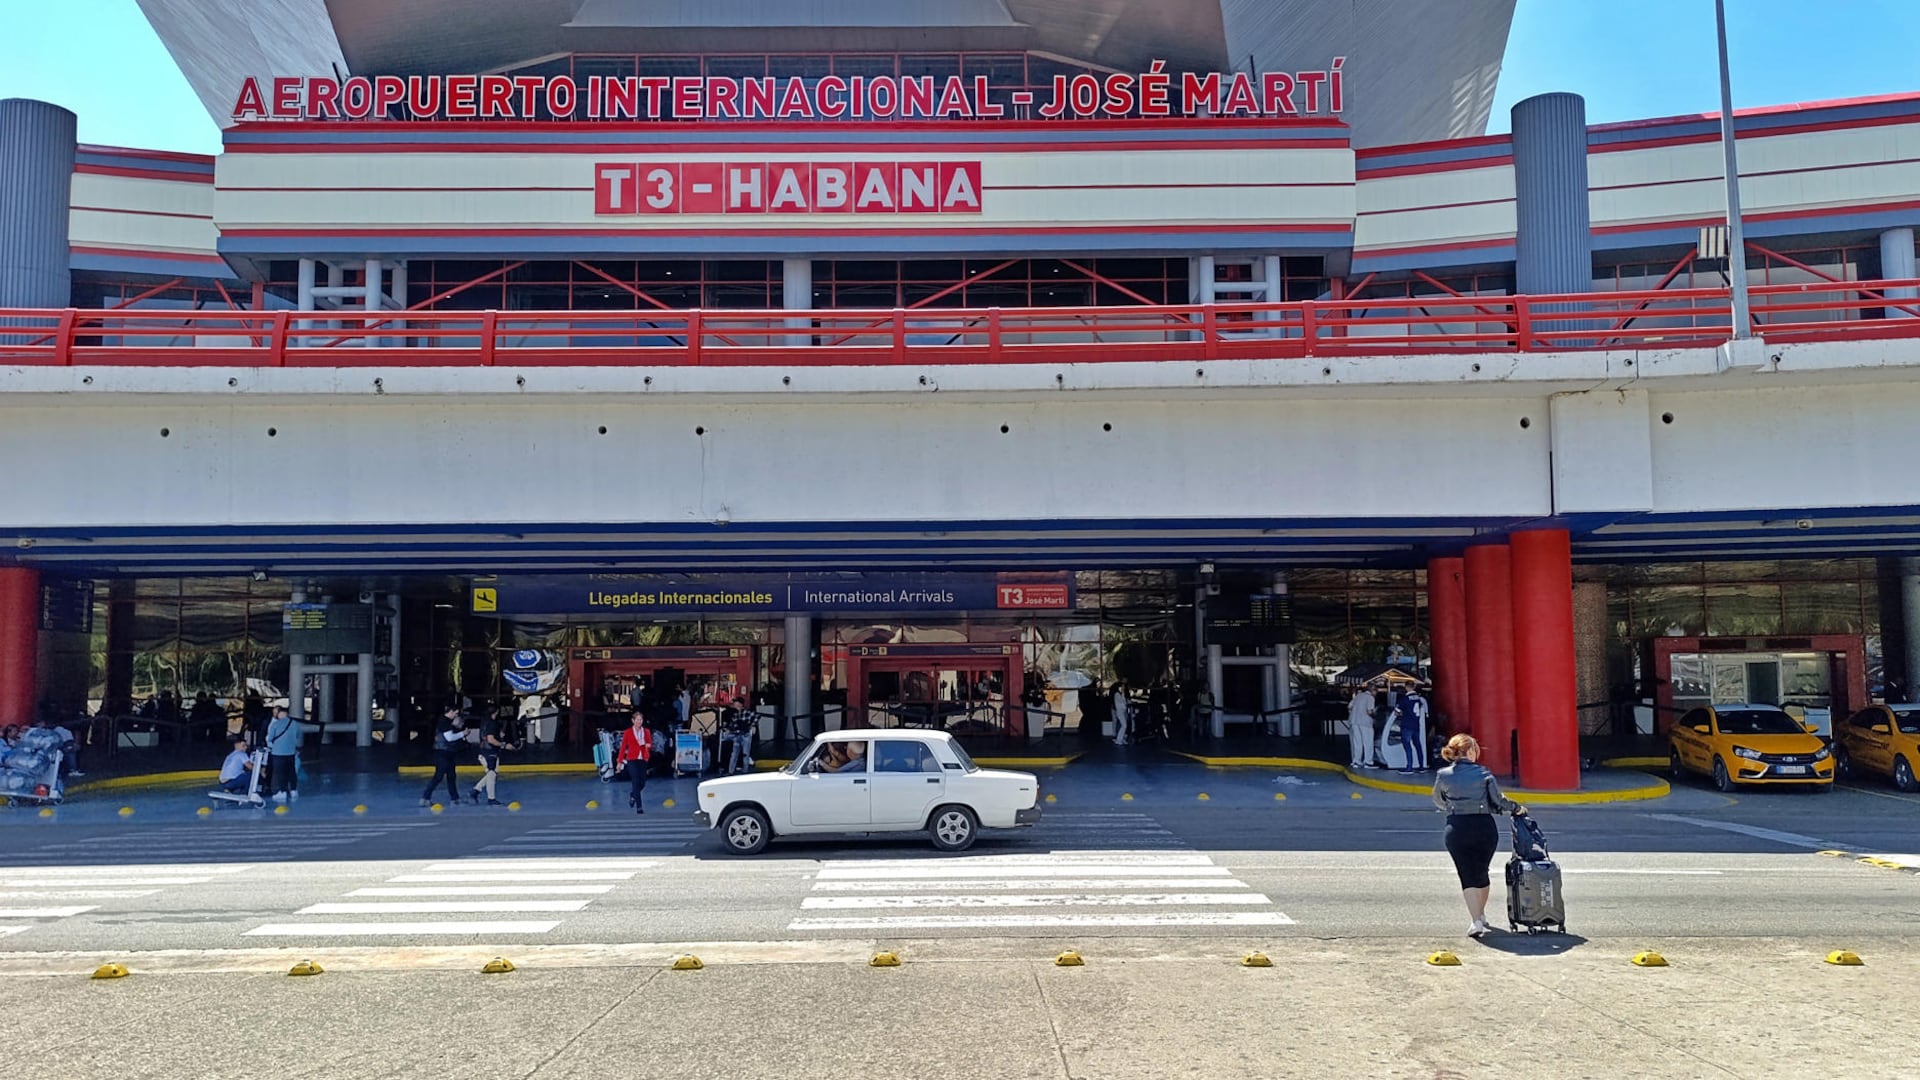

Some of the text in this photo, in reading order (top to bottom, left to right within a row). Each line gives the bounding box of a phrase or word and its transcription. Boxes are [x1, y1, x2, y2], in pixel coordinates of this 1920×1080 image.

[232, 75, 576, 118] AEROPUERTO
[587, 75, 1004, 118] INTERNACIONAL
[1038, 59, 1170, 117] JOSÉ
[1181, 56, 1348, 115] MARTÍ
[588, 590, 773, 608] Llegadas Internacionales
[804, 589, 954, 603] International Arrivals
[1000, 588, 1024, 605] T3
[584, 650, 592, 659] C
